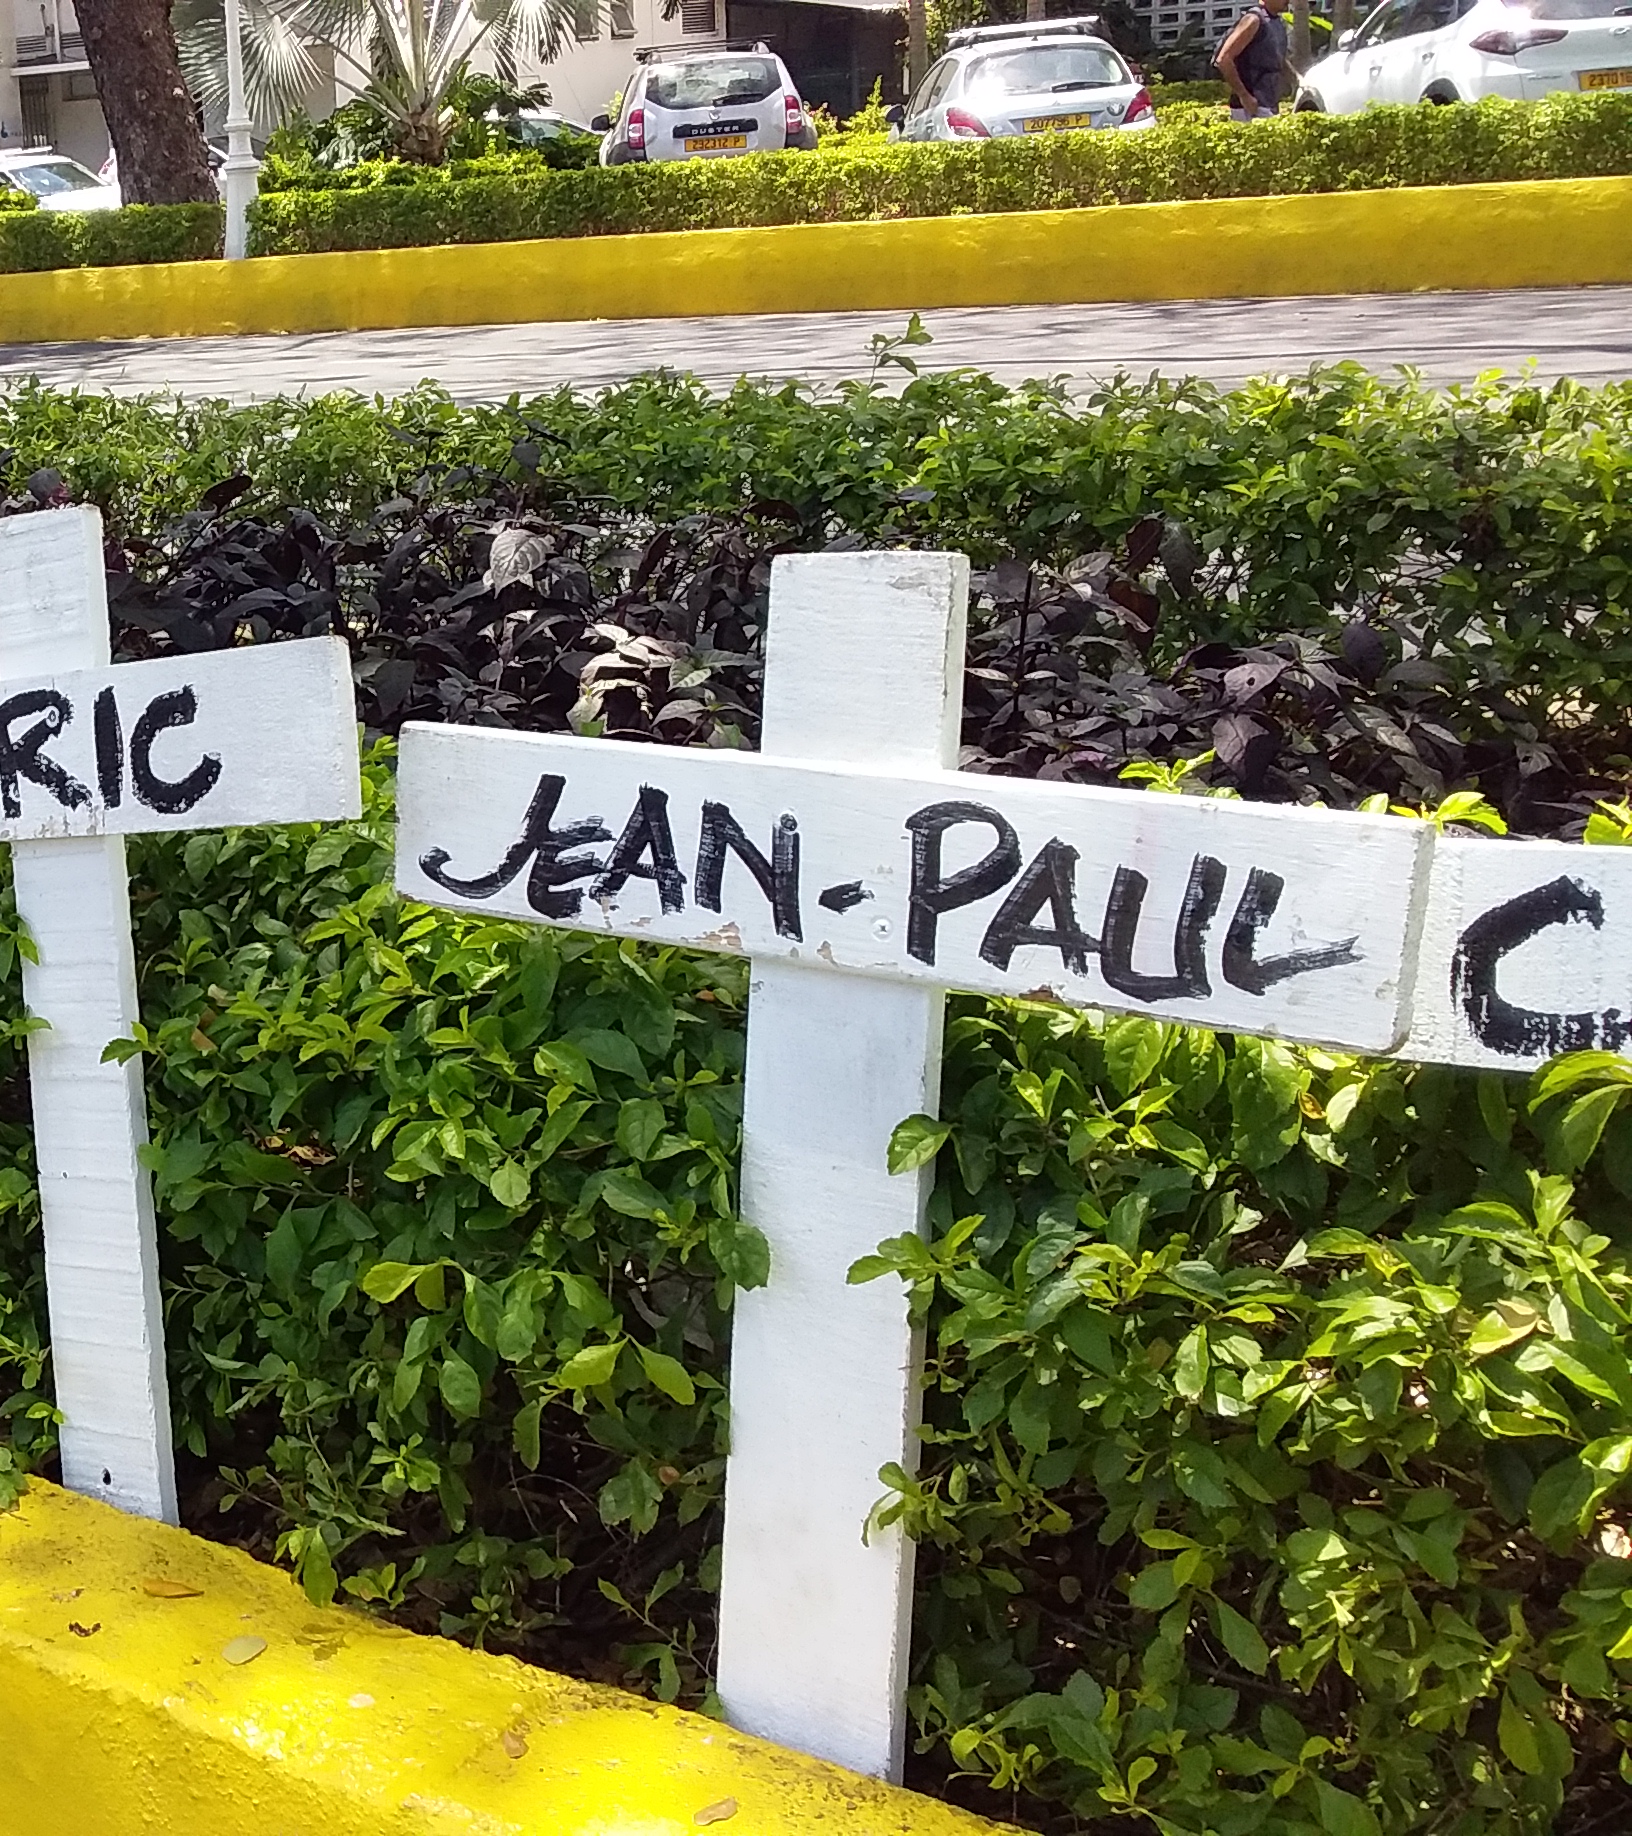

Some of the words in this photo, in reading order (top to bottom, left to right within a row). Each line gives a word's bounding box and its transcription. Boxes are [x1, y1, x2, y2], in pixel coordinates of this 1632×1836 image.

[1075, 113, 1082, 124] P
[691, 125, 739, 135] DUSTER
[733, 136, 740, 147] P
[418, 772, 1364, 1002] JEAN-PAUL
